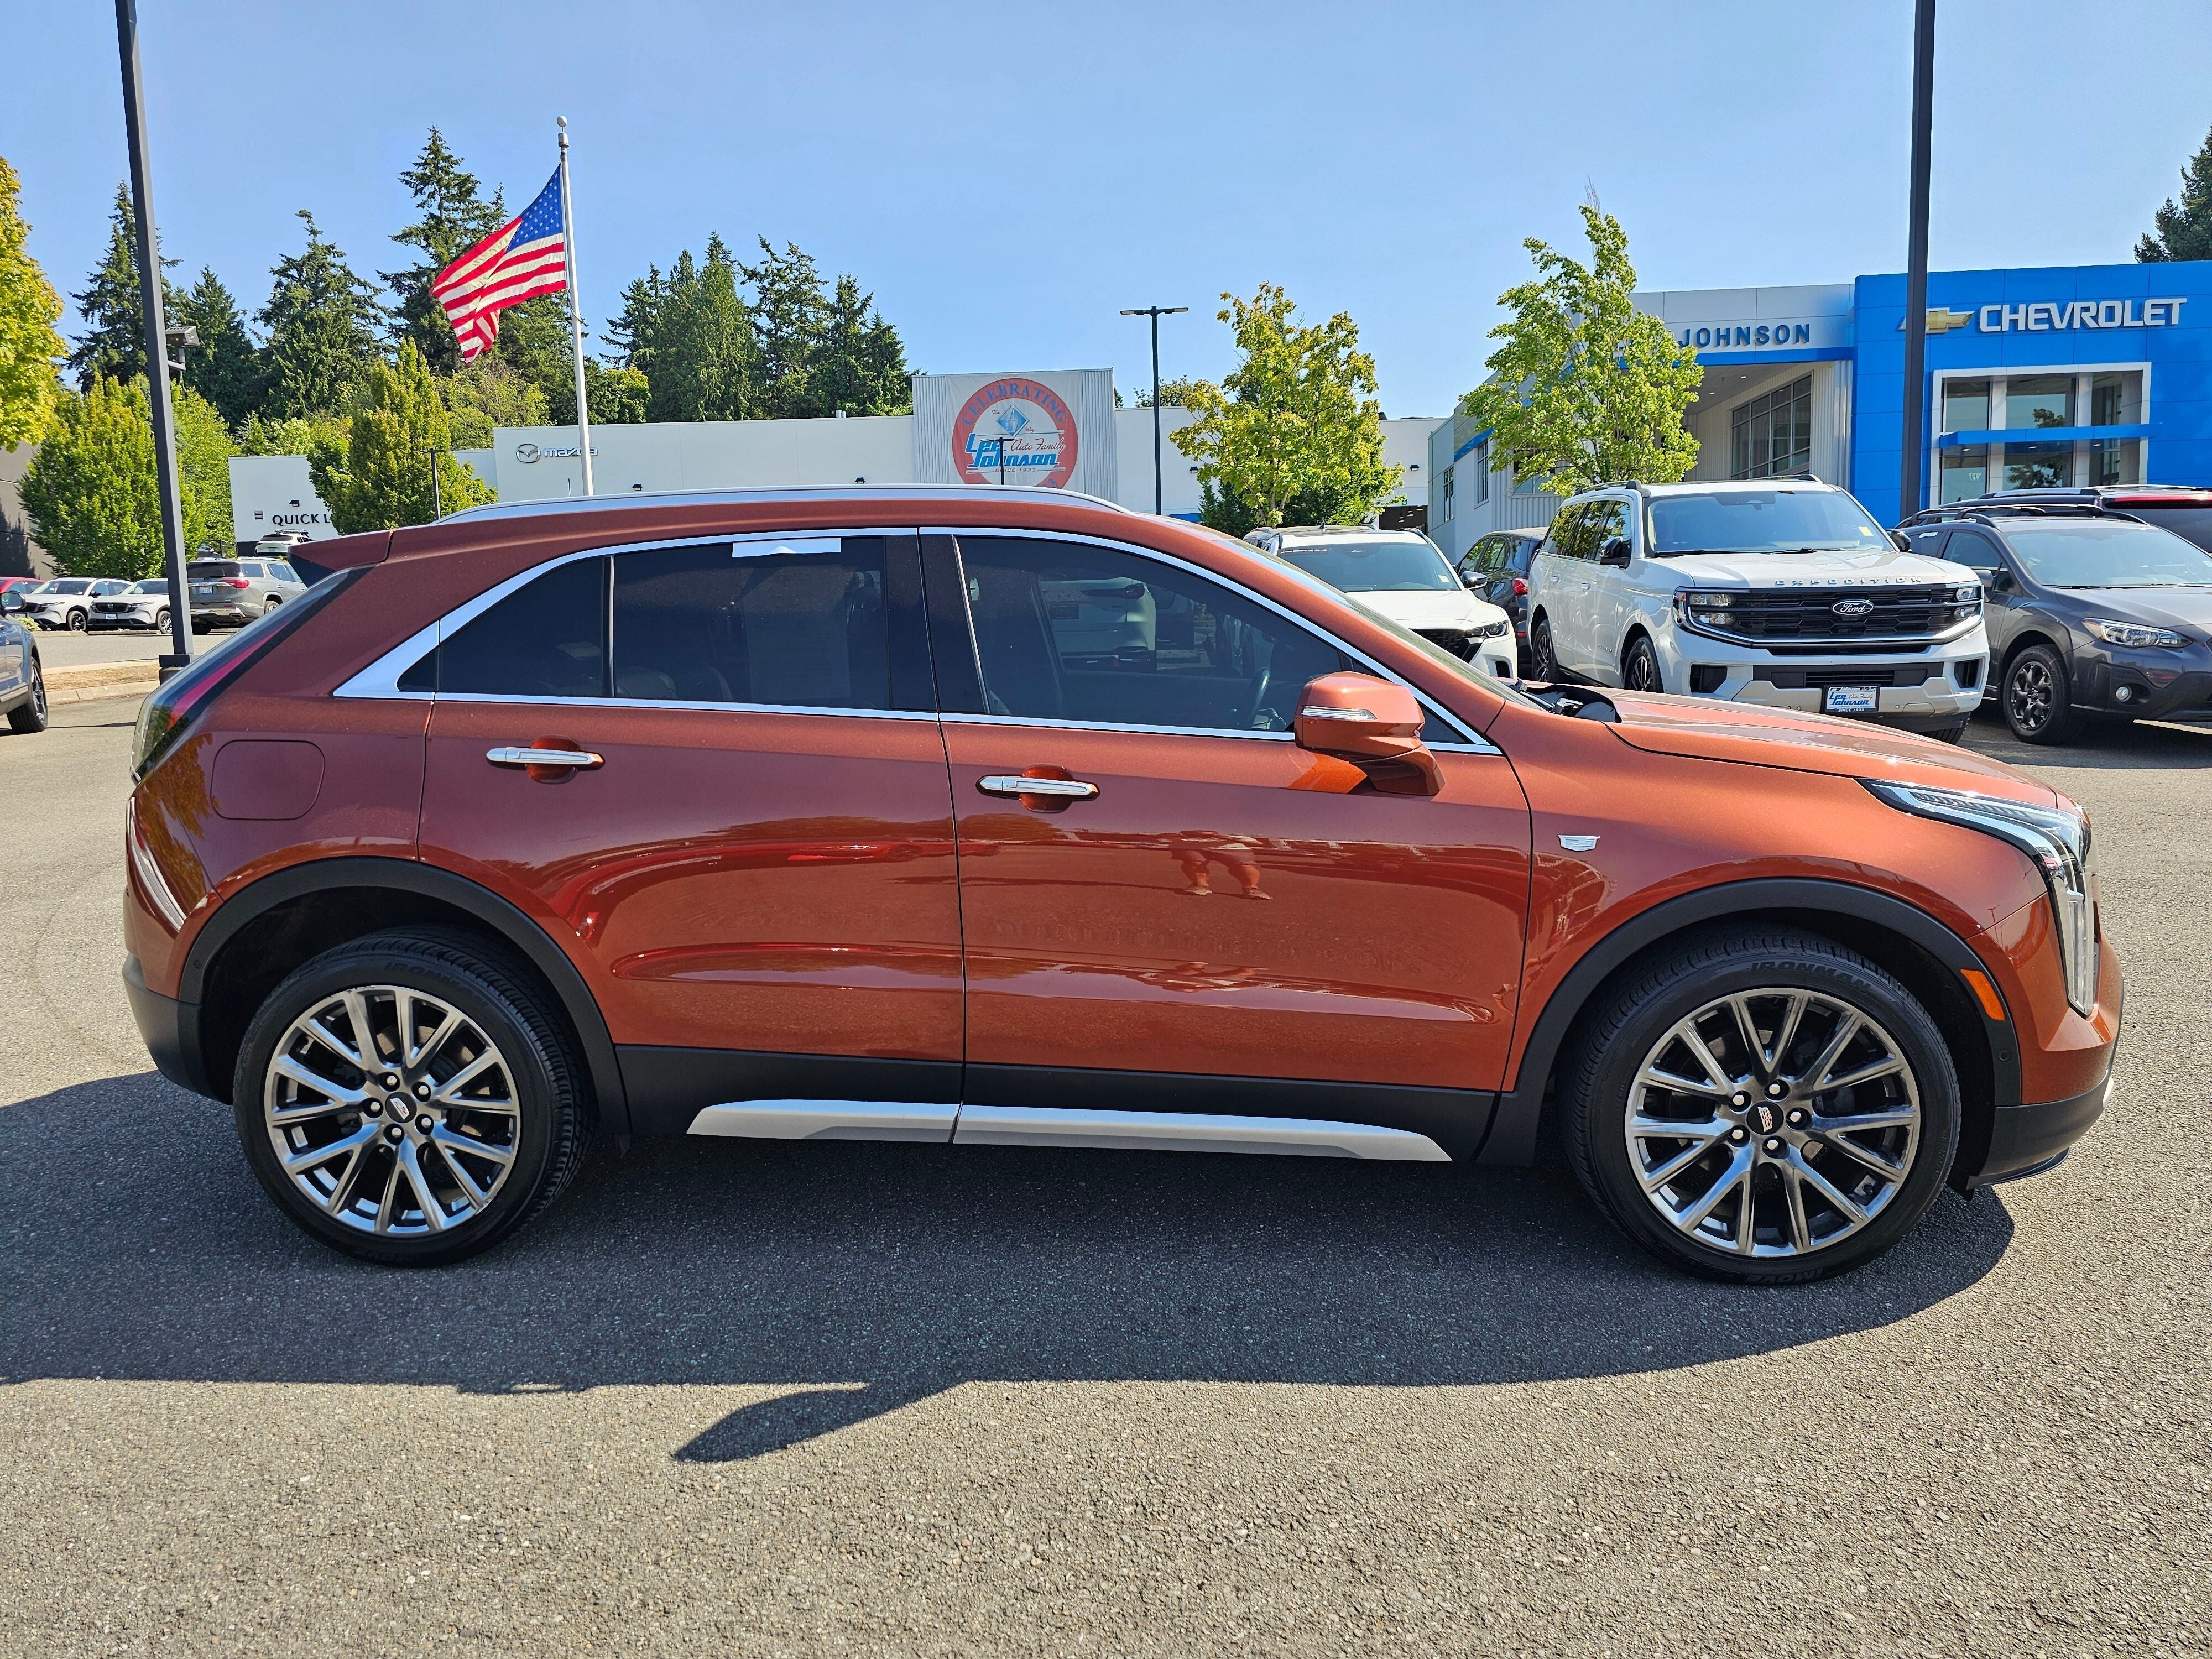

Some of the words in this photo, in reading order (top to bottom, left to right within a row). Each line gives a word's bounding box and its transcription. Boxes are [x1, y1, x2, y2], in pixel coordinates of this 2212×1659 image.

[1980, 298, 2187, 332] CHEVROLET
[1678, 324, 1810, 348] JOHNSON
[962, 382, 1068, 426] CELEBRATING
[966, 433, 1006, 452] Lee
[1011, 438, 1032, 451] Auto
[1035, 437, 1065, 453] Family
[272, 514, 320, 526] QUICK
[1775, 576, 1923, 587] EXPEDITION
[1840, 602, 1865, 613] Ford
[1829, 691, 1847, 700] Lee
[1829, 697, 1870, 705] Johnson
[1750, 961, 1872, 990] IRONMAN
